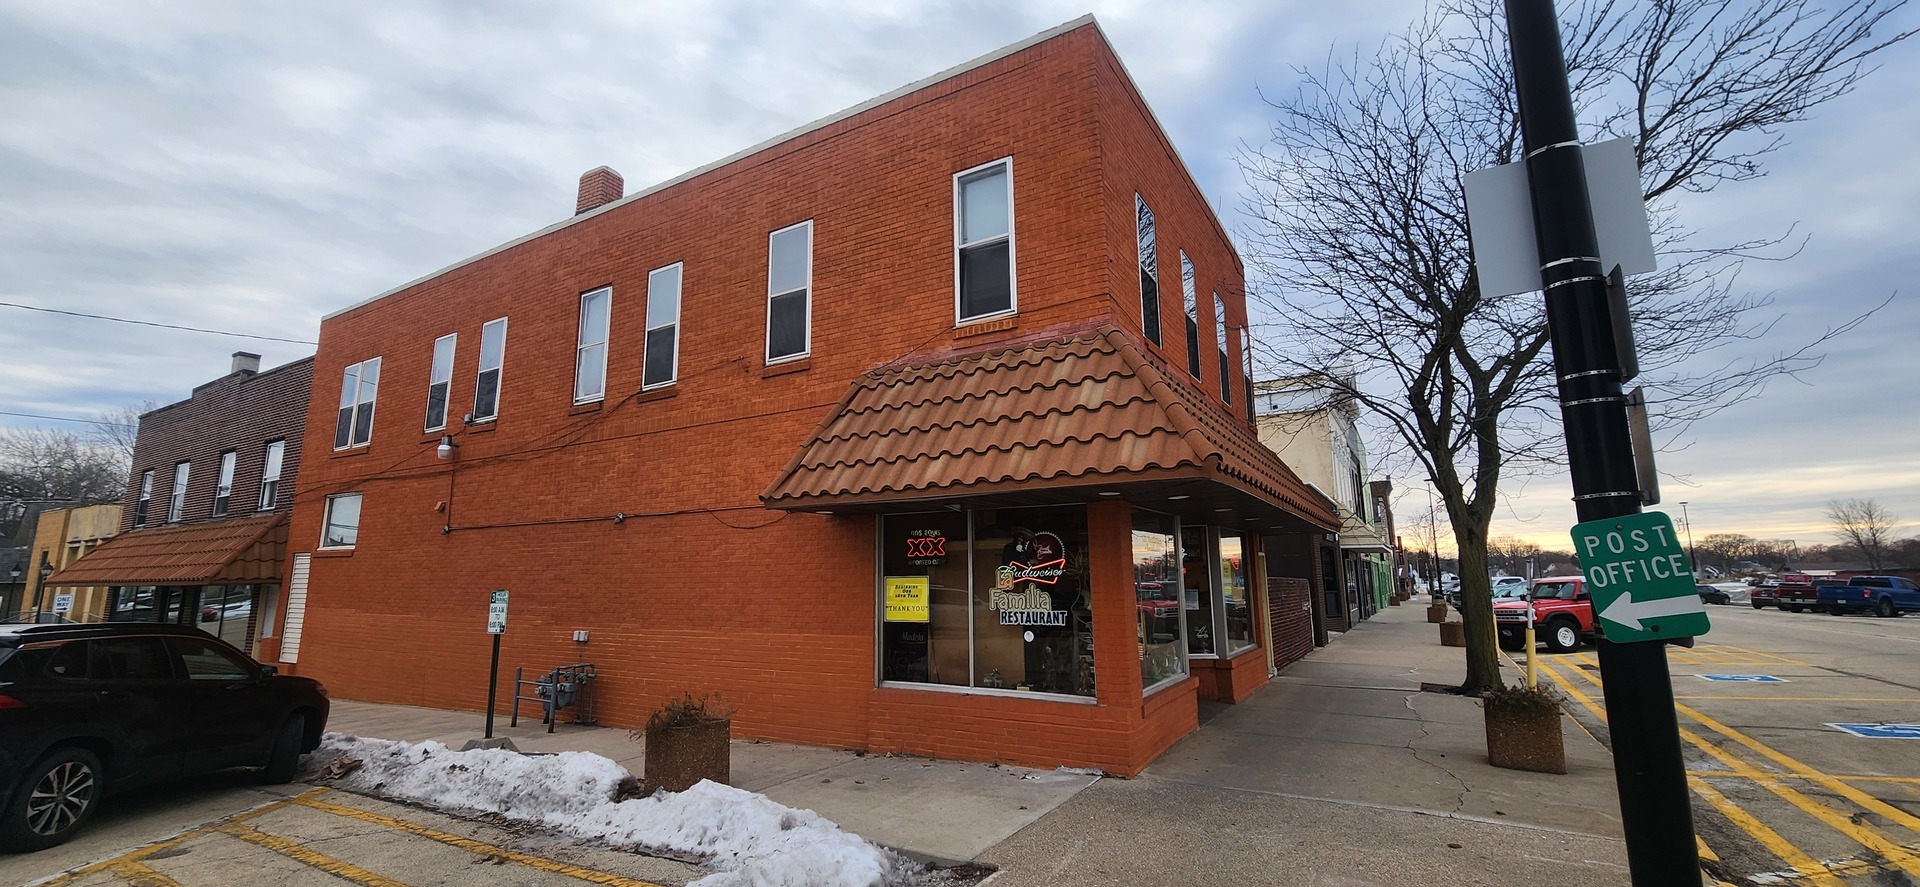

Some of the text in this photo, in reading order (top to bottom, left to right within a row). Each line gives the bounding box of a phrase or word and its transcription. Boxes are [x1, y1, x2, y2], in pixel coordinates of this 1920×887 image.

[907, 537, 946, 557] XX
[1583, 525, 1668, 558] POST
[995, 568, 1014, 590] La
[998, 561, 1066, 578] Budweiser
[1589, 553, 1690, 588] OFFICE
[989, 583, 1052, 611] Familia
[1001, 610, 1067, 625] RESTAURANT
